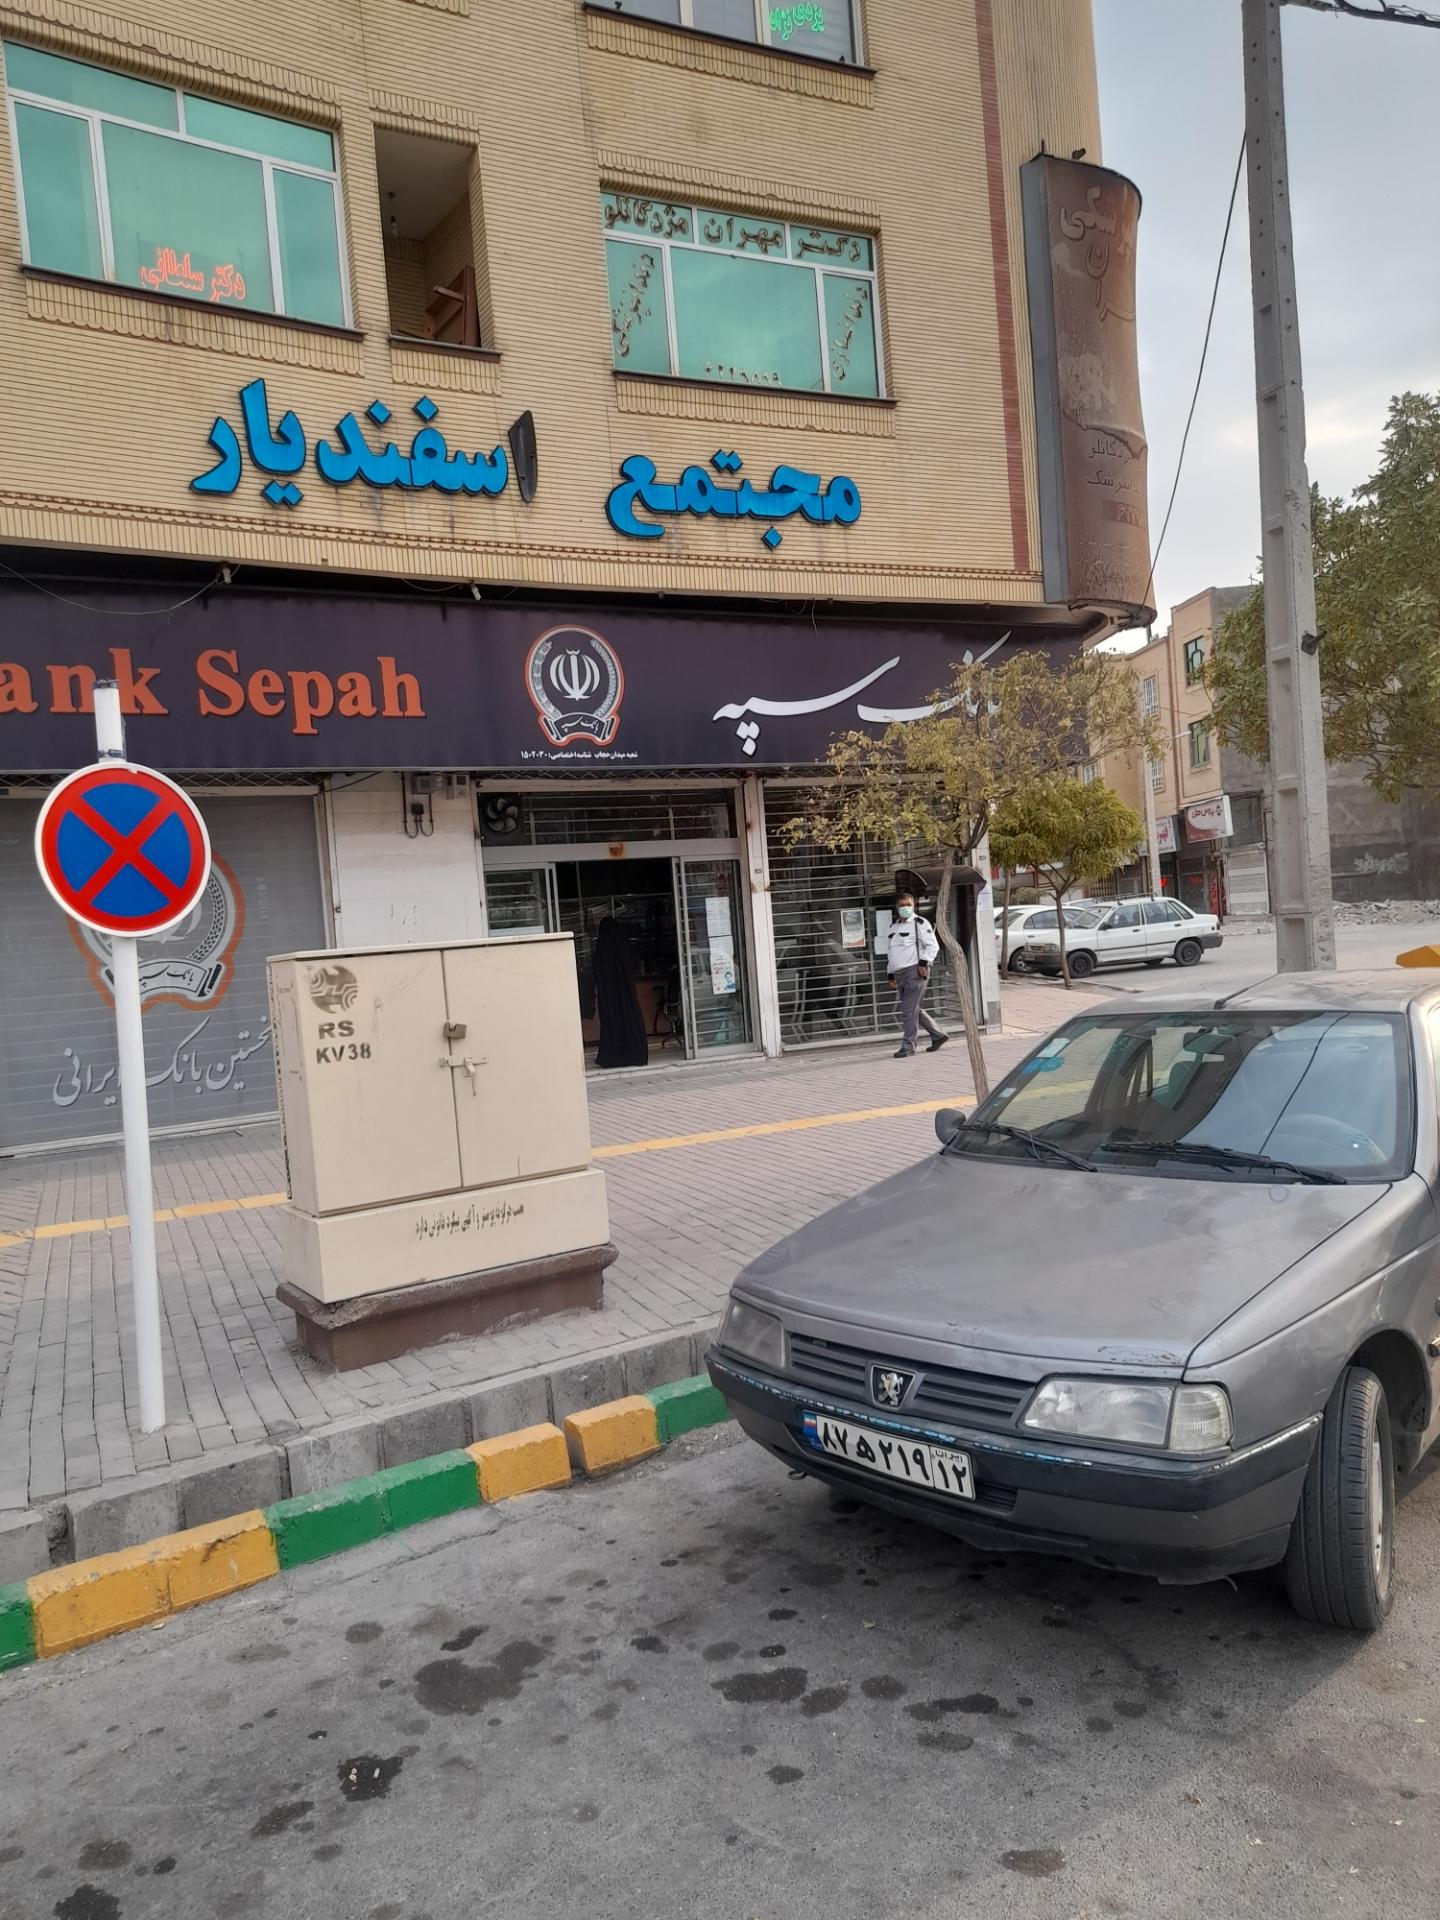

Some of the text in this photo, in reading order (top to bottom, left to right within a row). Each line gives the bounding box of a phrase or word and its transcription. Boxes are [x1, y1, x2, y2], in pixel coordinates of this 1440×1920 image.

[703, 217, 784, 254] مهران
[795, 229, 861, 262] دکتر
[141, 247, 246, 303] دکتر سلطانی
[189, 377, 862, 551] مجتمع اسفندیار
[196, 648, 427, 735] Sepah
[712, 630, 1011, 756] نک سپه
[167, 968, 194, 986] بانک
[318, 1020, 355, 1039] RS
[145, 1015, 209, 1095] بانک
[206, 1015, 273, 1091] خستین
[315, 1042, 372, 1065] KV38
[935, 1449, 963, 1463] ایران
[937, 1459, 967, 1494] ۱۲
